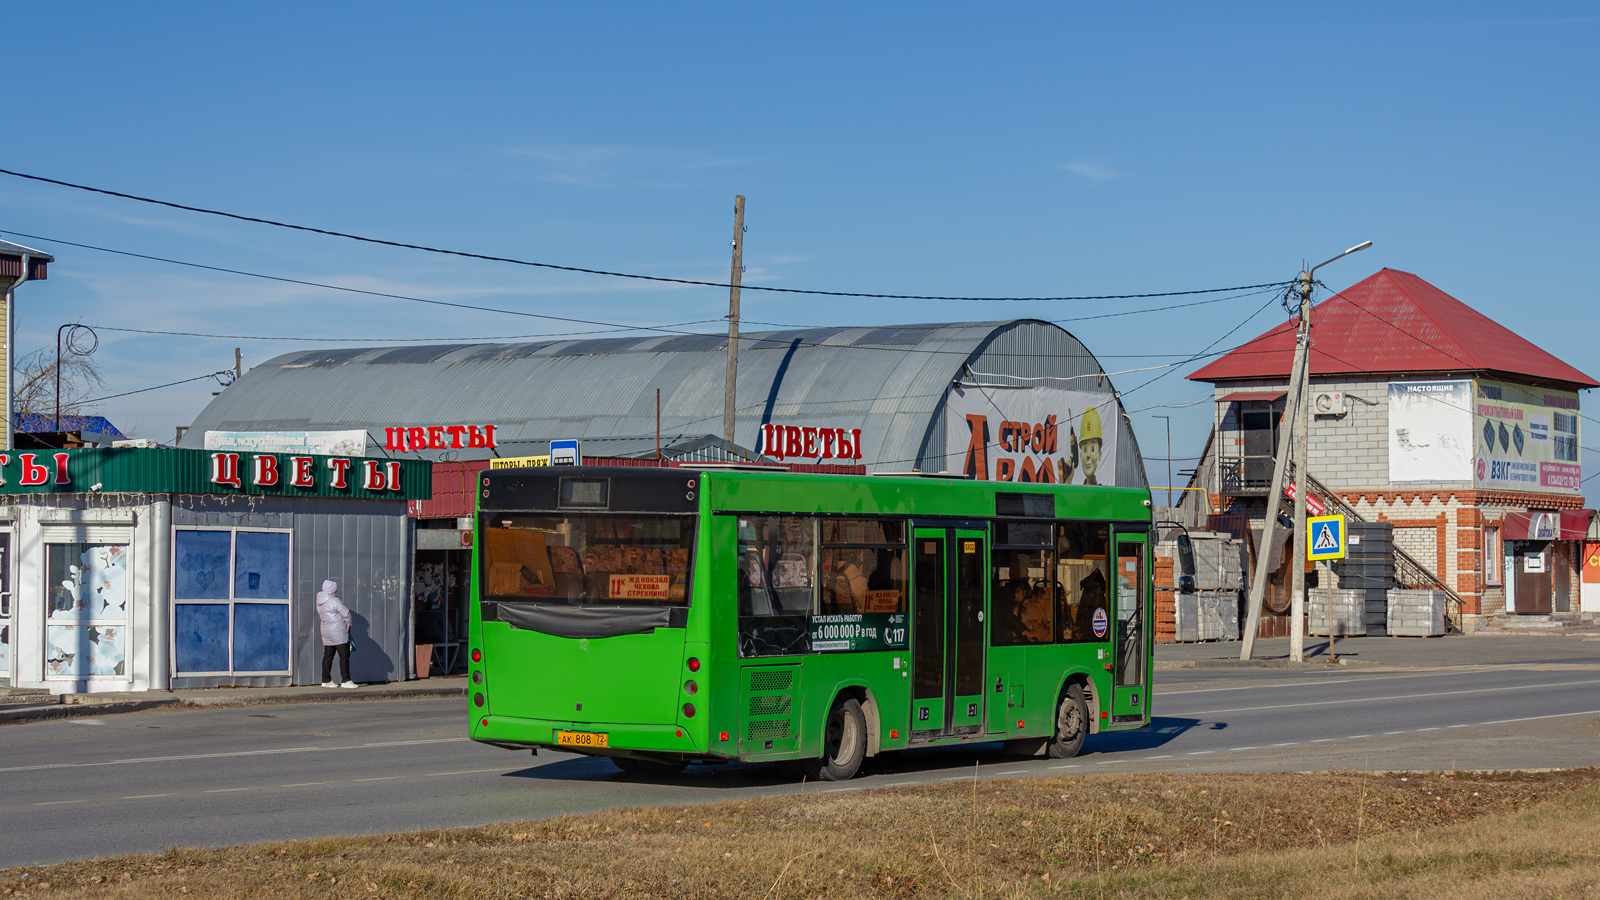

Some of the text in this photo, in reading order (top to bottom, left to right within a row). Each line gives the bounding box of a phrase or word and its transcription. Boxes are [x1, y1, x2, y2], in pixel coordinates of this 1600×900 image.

[384, 424, 499, 453] ЦВЕТЫ
[760, 423, 862, 461] ЦВЕТЫ
[998, 414, 1058, 455] СТРОЙ
[210, 453, 402, 491] ЦВЕТЫ
[1491, 460, 1511, 480] ВЗКГ
[812, 614, 862, 623] УСТАЛ ИСКАТЬ РАБОТУ?
[818, 625, 823, 639] 6
[824, 624, 839, 639] 000
[840, 624, 854, 638] 000
[866, 627, 877, 639] год
[892, 628, 904, 642] 117
[575, 734, 592, 744] 808
[596, 735, 604, 743] 72
